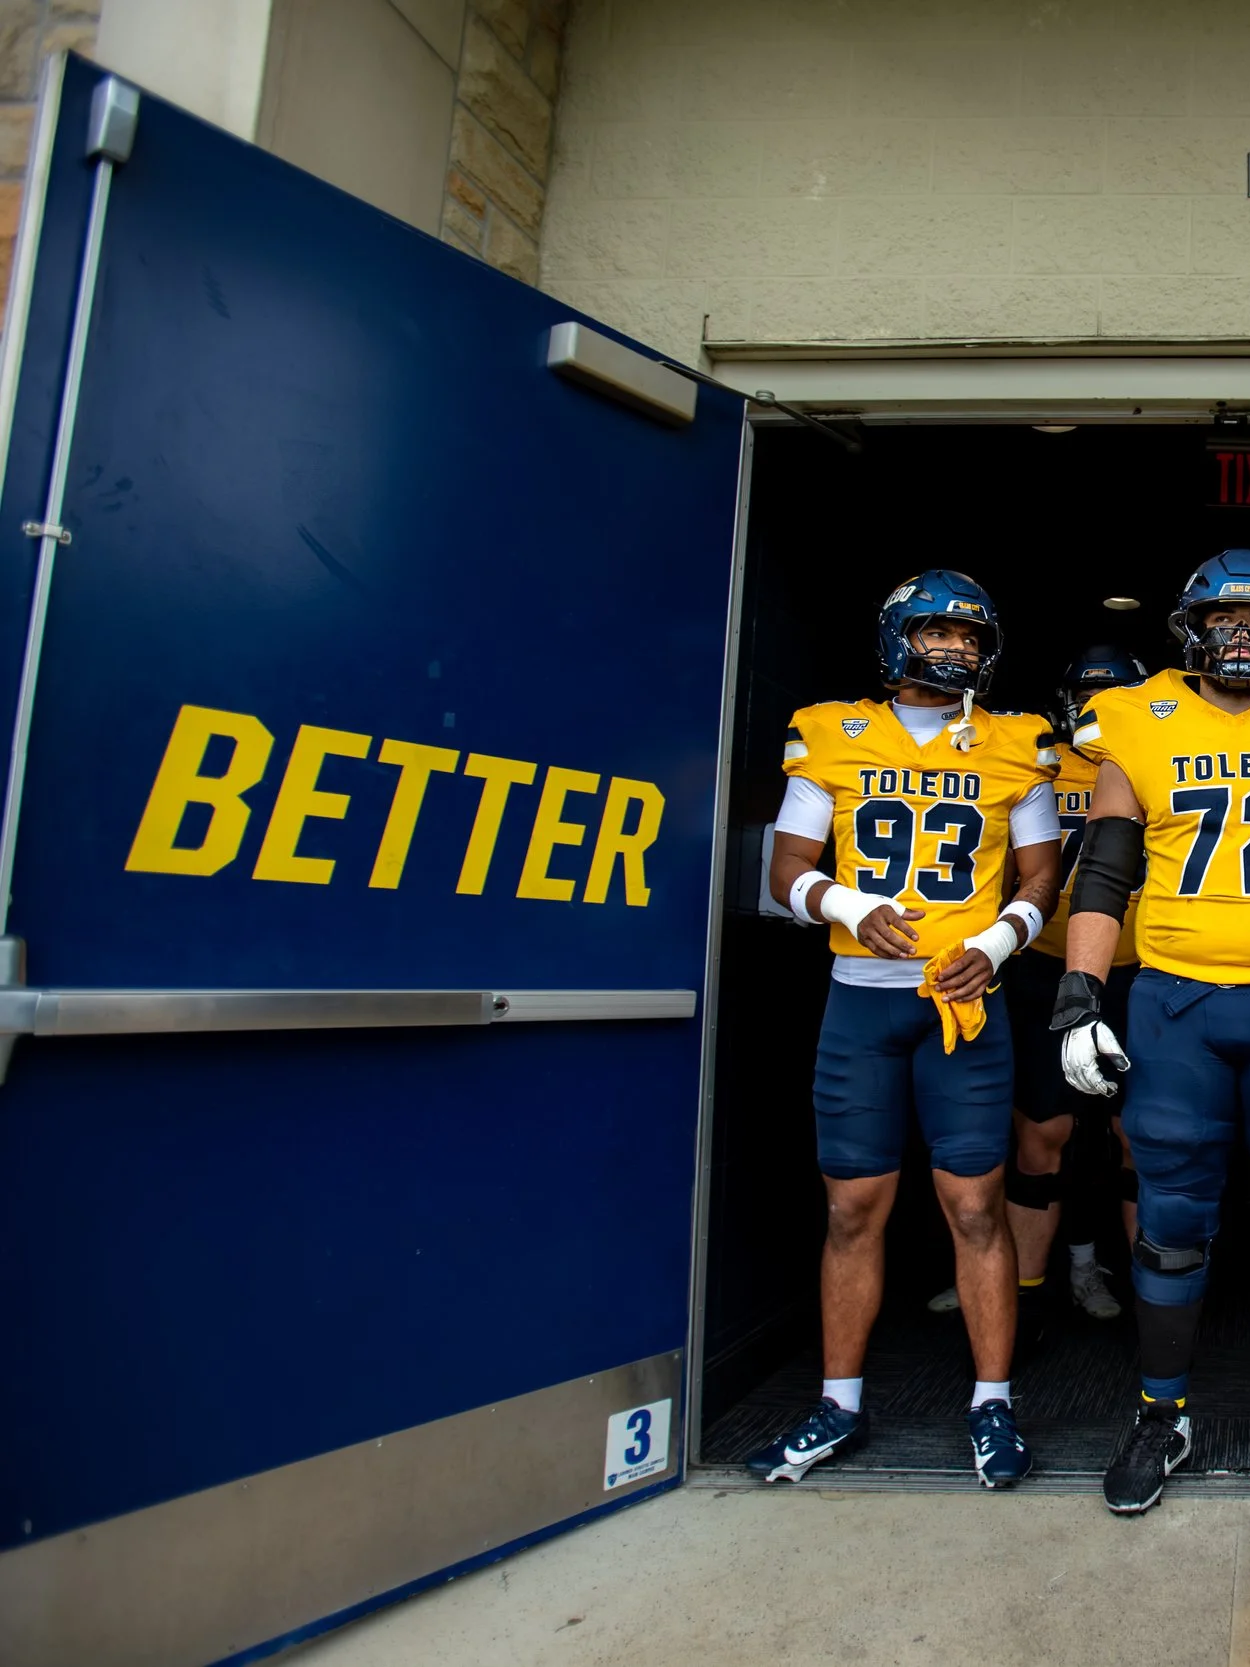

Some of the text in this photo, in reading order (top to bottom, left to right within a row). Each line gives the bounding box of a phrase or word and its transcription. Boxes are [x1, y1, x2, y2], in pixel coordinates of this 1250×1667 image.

[124, 704, 666, 907] BETTER
[859, 768, 981, 800] TOLEDO
[853, 797, 985, 904] 93
[624, 1409, 652, 1465] 3
